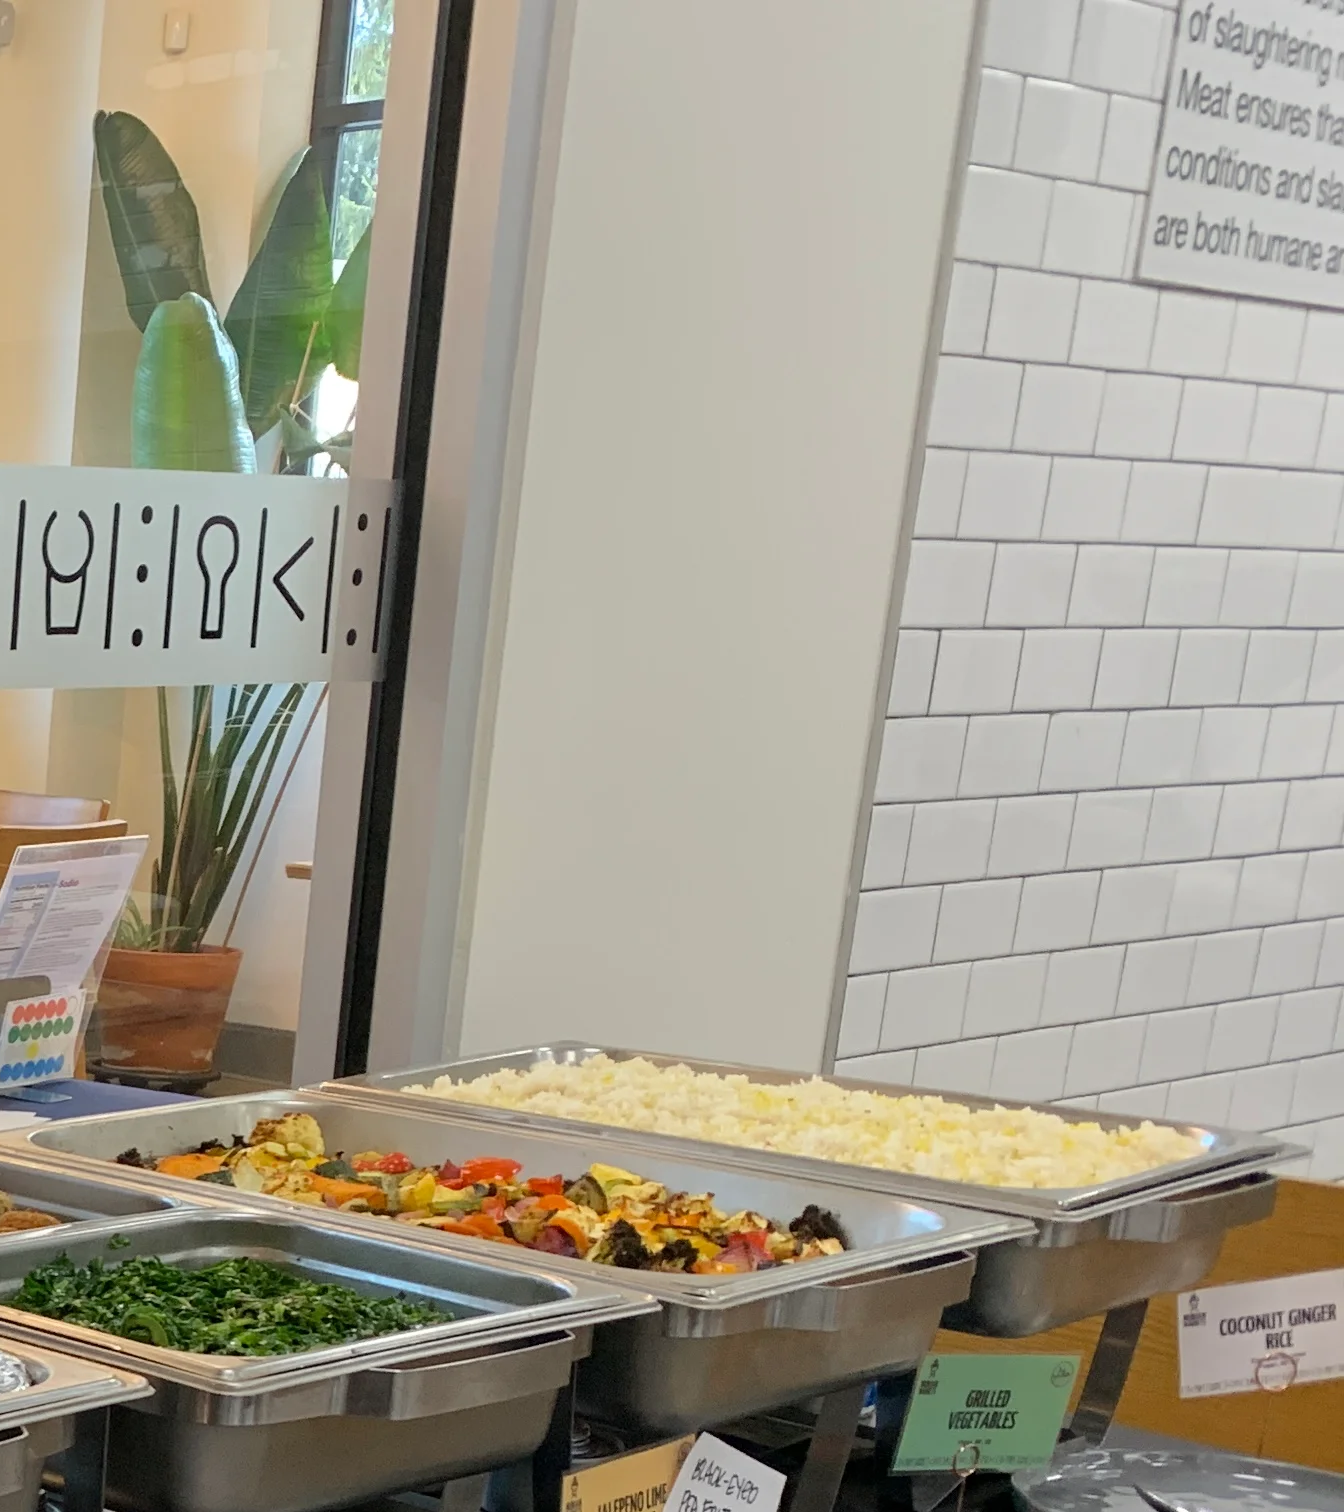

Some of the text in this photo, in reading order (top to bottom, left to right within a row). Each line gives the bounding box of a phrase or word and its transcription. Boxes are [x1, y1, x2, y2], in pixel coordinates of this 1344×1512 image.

[1188, 2, 1214, 43] of
[1214, 8, 1332, 87] slaughtering
[1177, 68, 1344, 146] Meat ensures tha
[1166, 145, 1272, 196] conditions
[1275, 166, 1315, 204] and
[1154, 214, 1188, 249] are
[1192, 211, 1241, 256] both
[1244, 219, 1324, 271] humane
[1219, 1310, 1285, 1336] COCONUT
[1288, 1303, 1337, 1327] GINGER
[1265, 1329, 1294, 1350] RICE
[965, 1389, 1012, 1408] GRILLED
[948, 1411, 1019, 1430] VEGETABLES
[646, 1483, 667, 1509] LIME
